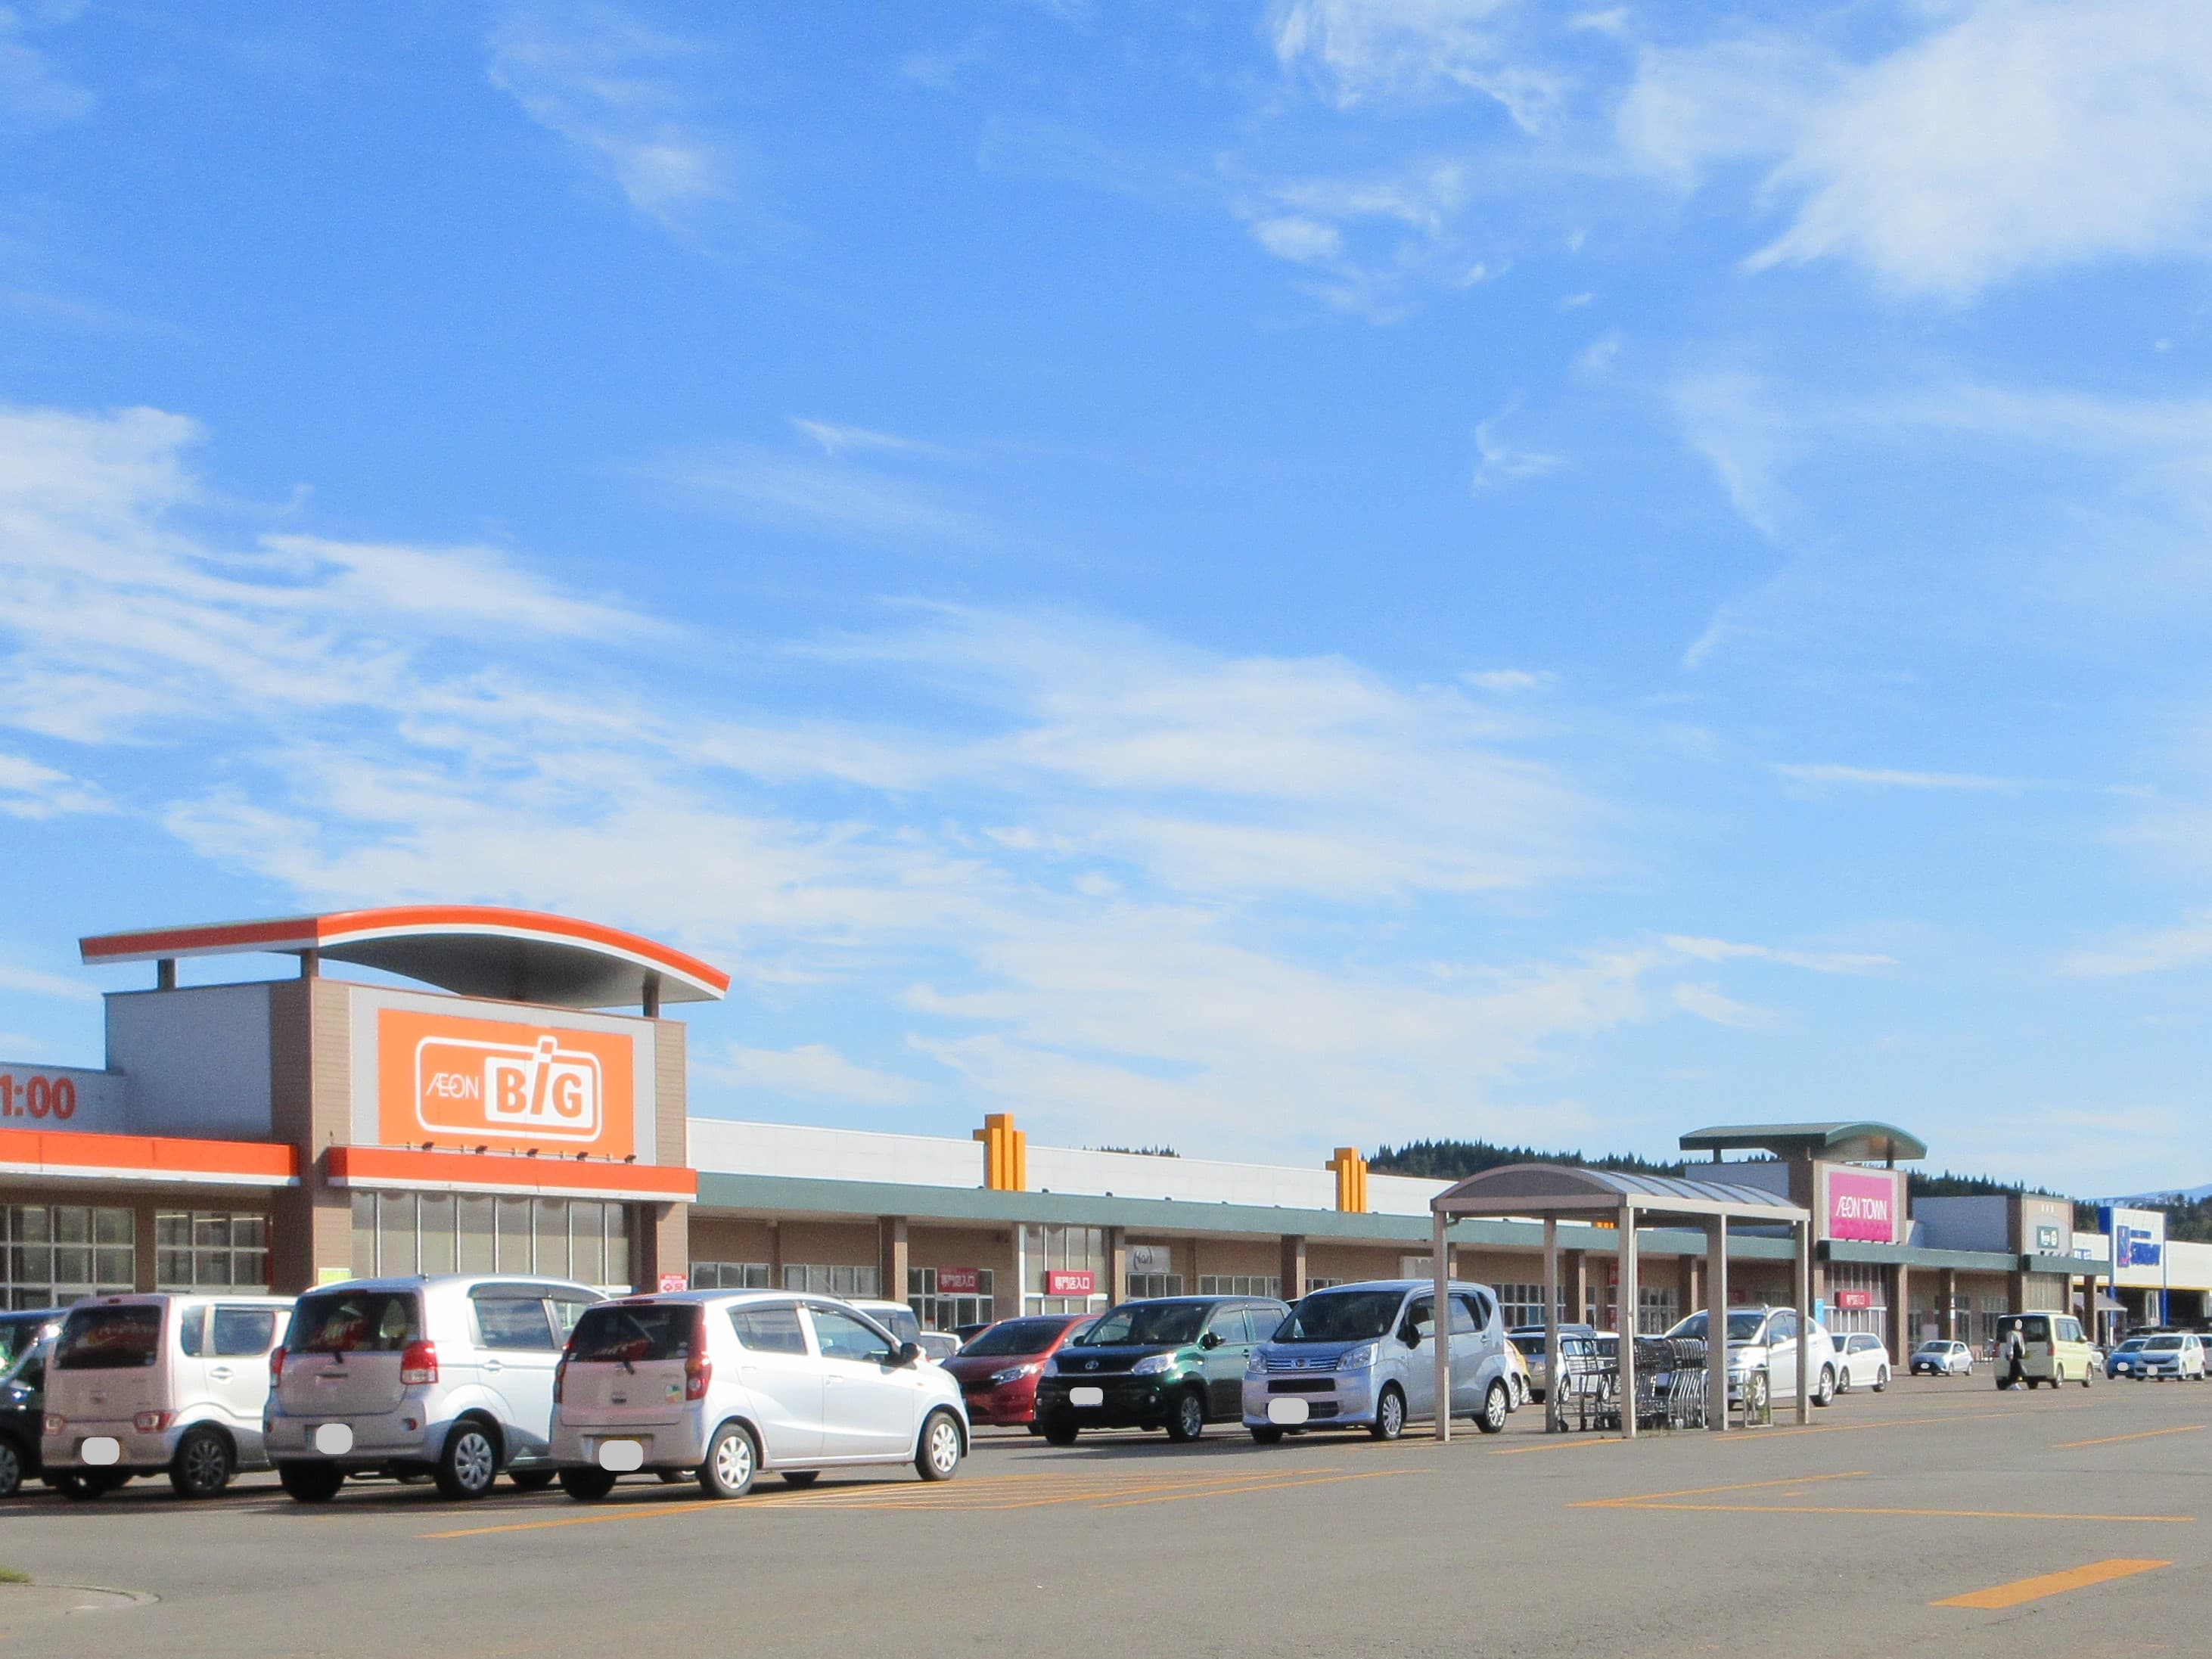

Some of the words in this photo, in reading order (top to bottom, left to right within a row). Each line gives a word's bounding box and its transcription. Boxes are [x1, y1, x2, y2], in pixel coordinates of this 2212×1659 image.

[1861, 1198, 1887, 1221] TOWN
[1055, 1276, 1090, 1290] 専門店入口
